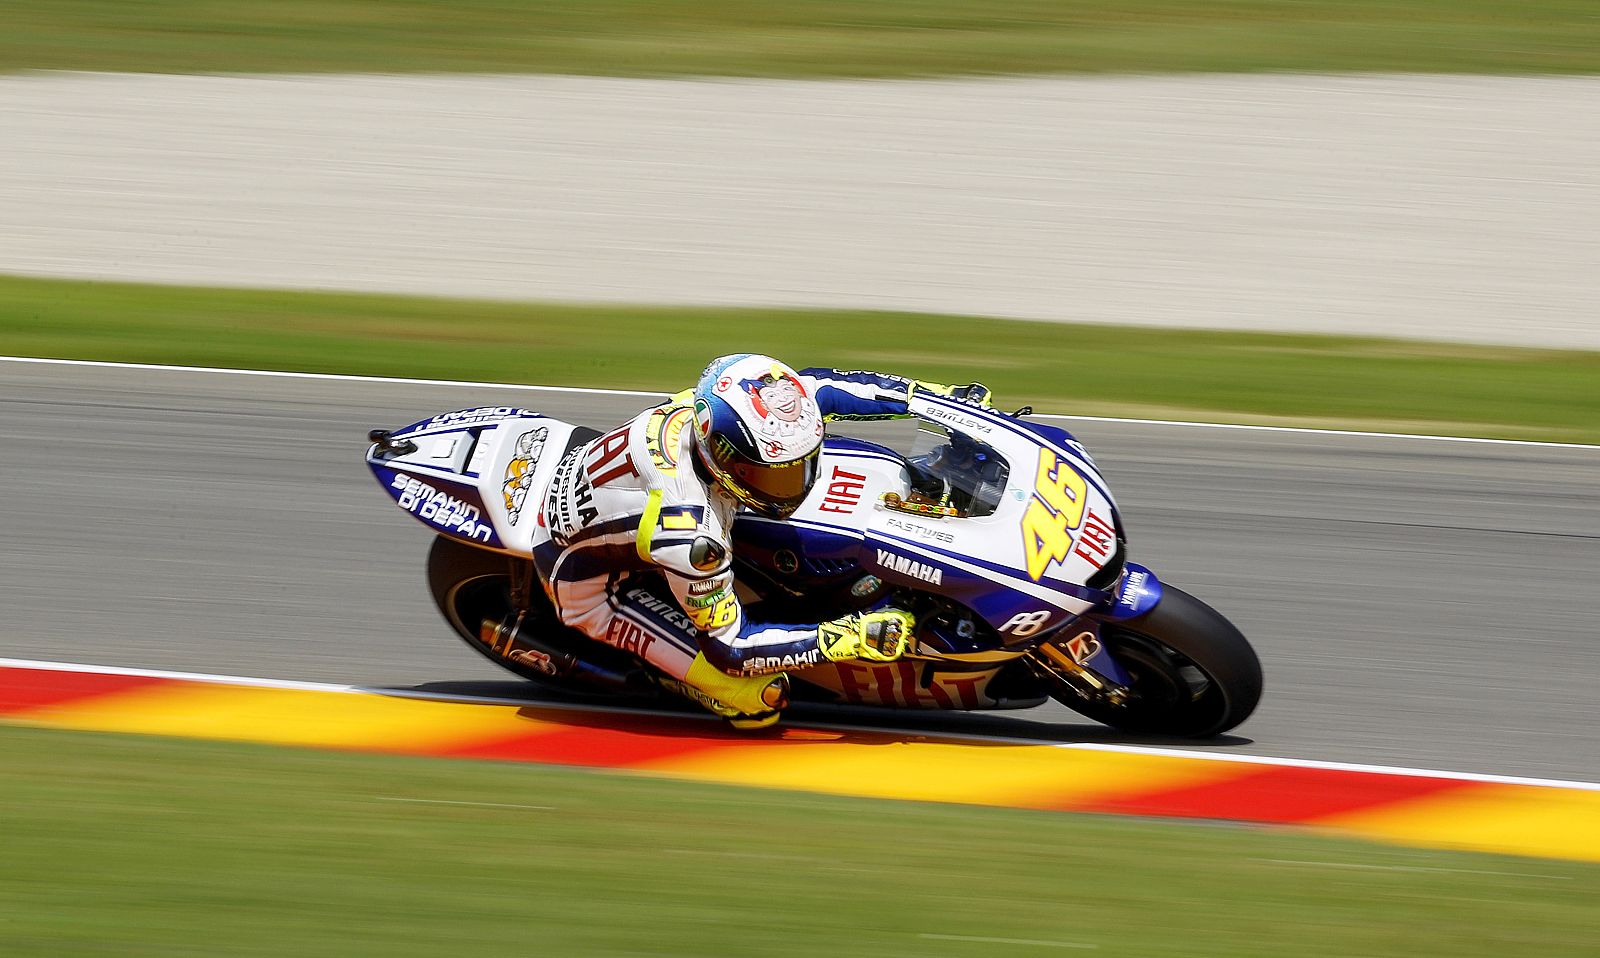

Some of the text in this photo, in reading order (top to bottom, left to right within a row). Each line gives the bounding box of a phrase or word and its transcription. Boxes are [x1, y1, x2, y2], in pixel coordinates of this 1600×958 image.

[391, 473, 481, 521] SEMAKIN
[819, 465, 867, 515] FIAT
[1021, 447, 1087, 581] 46
[398, 492, 493, 542] DI DEPAN
[1074, 508, 1116, 569] FIAT
[876, 549, 943, 586] YAMAHA
[606, 615, 656, 660] FIAT
